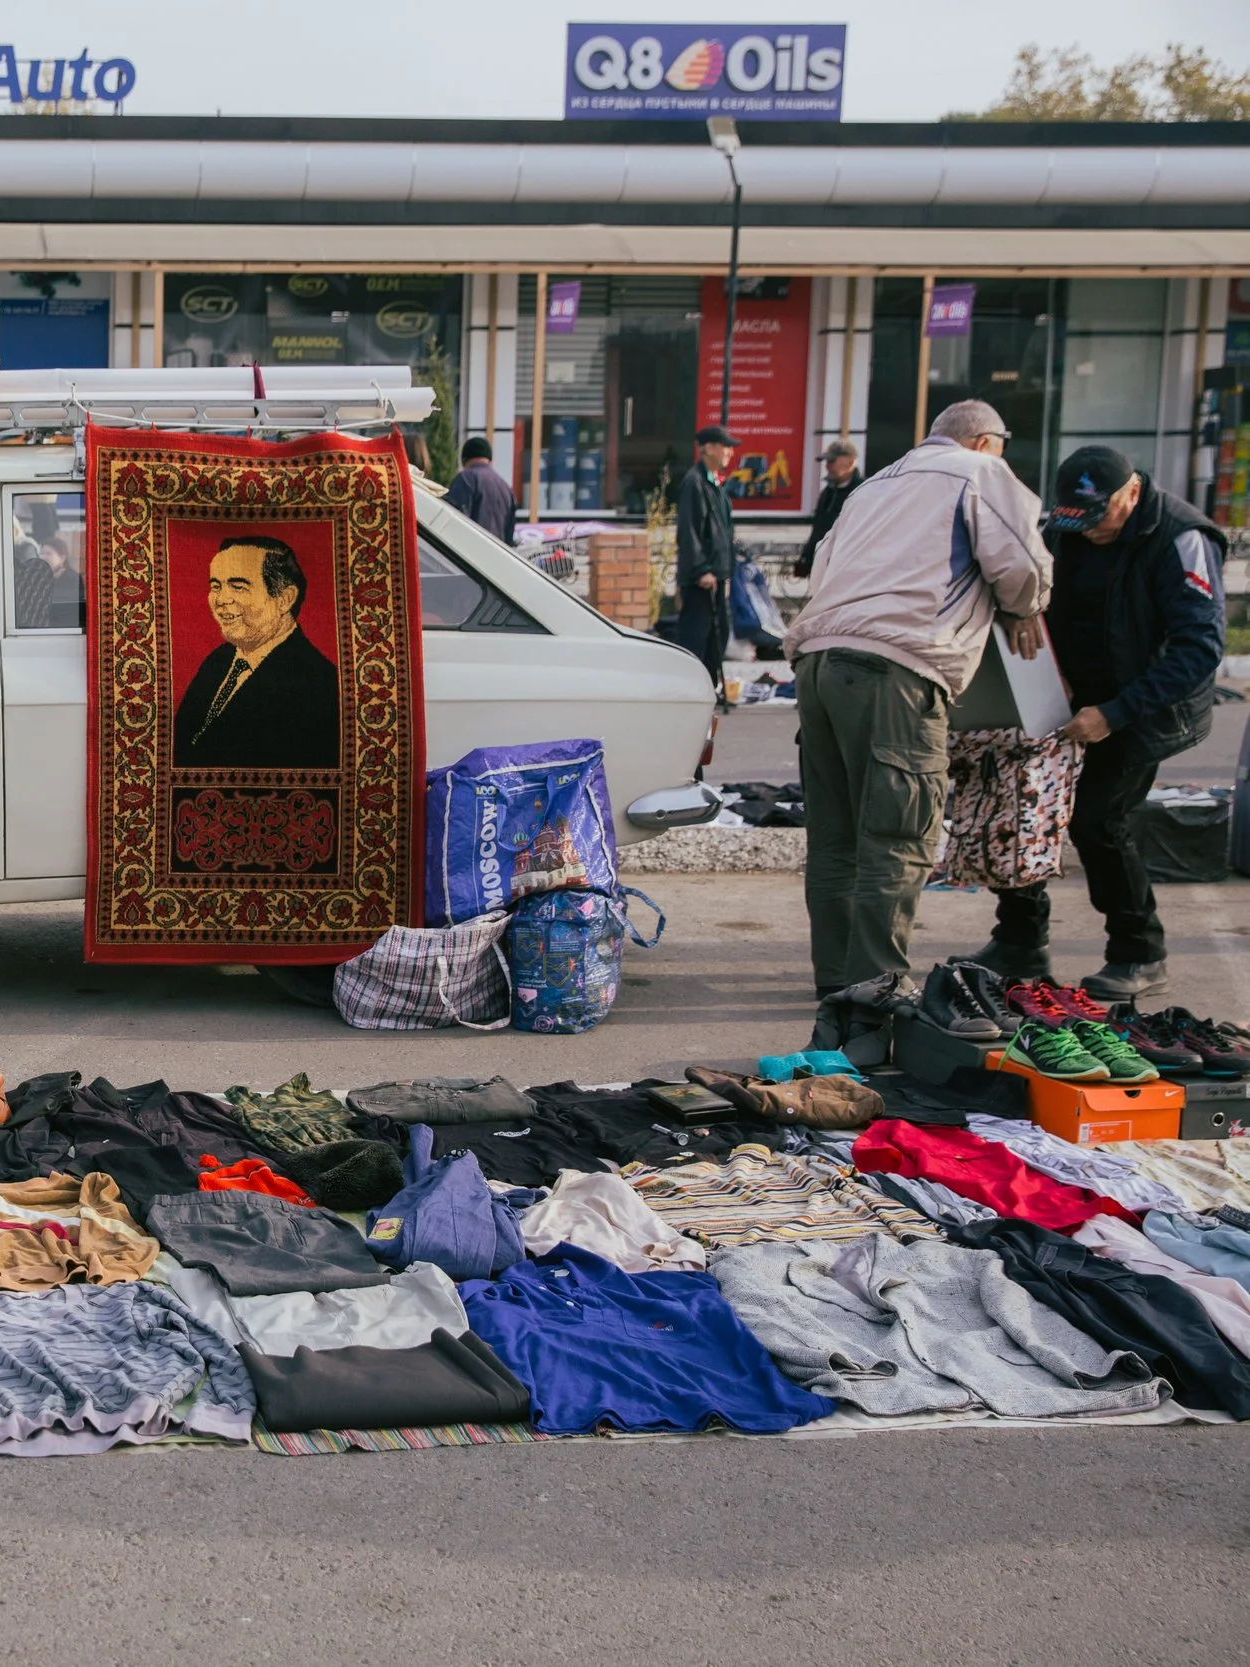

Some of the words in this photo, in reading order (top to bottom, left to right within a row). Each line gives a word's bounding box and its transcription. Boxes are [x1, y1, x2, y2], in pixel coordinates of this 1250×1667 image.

[574, 35, 664, 90] Q8
[726, 34, 841, 92] Oils
[186, 297, 234, 313] SCT
[382, 311, 430, 328] SCT
[272, 336, 343, 349] MANNOL
[479, 800, 504, 911] MOSCOW
